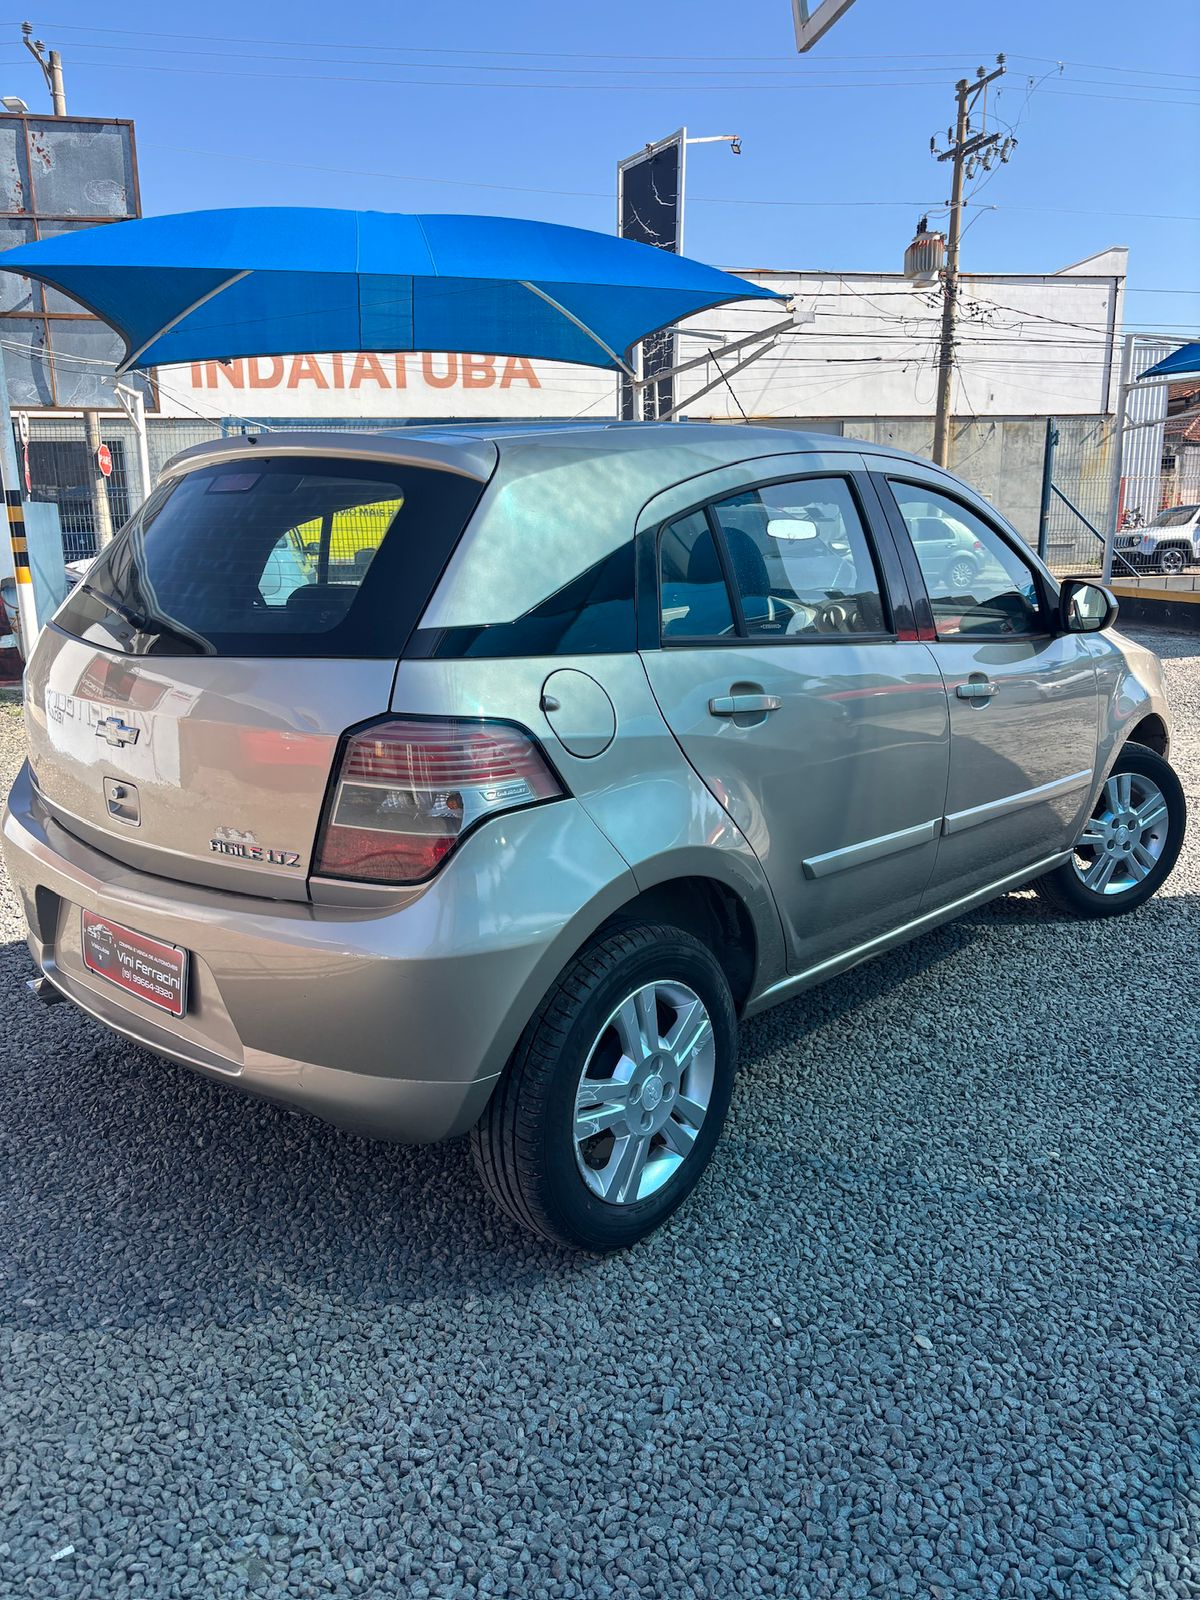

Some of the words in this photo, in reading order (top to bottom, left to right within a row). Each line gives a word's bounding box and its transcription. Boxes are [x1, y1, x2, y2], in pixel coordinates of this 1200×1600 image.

[191, 352, 541, 388] INDAIATUBA
[209, 838, 264, 861] AGILE
[266, 849, 301, 868] LTZ
[116, 949, 134, 968] Vini
[135, 959, 180, 990] Ferracini
